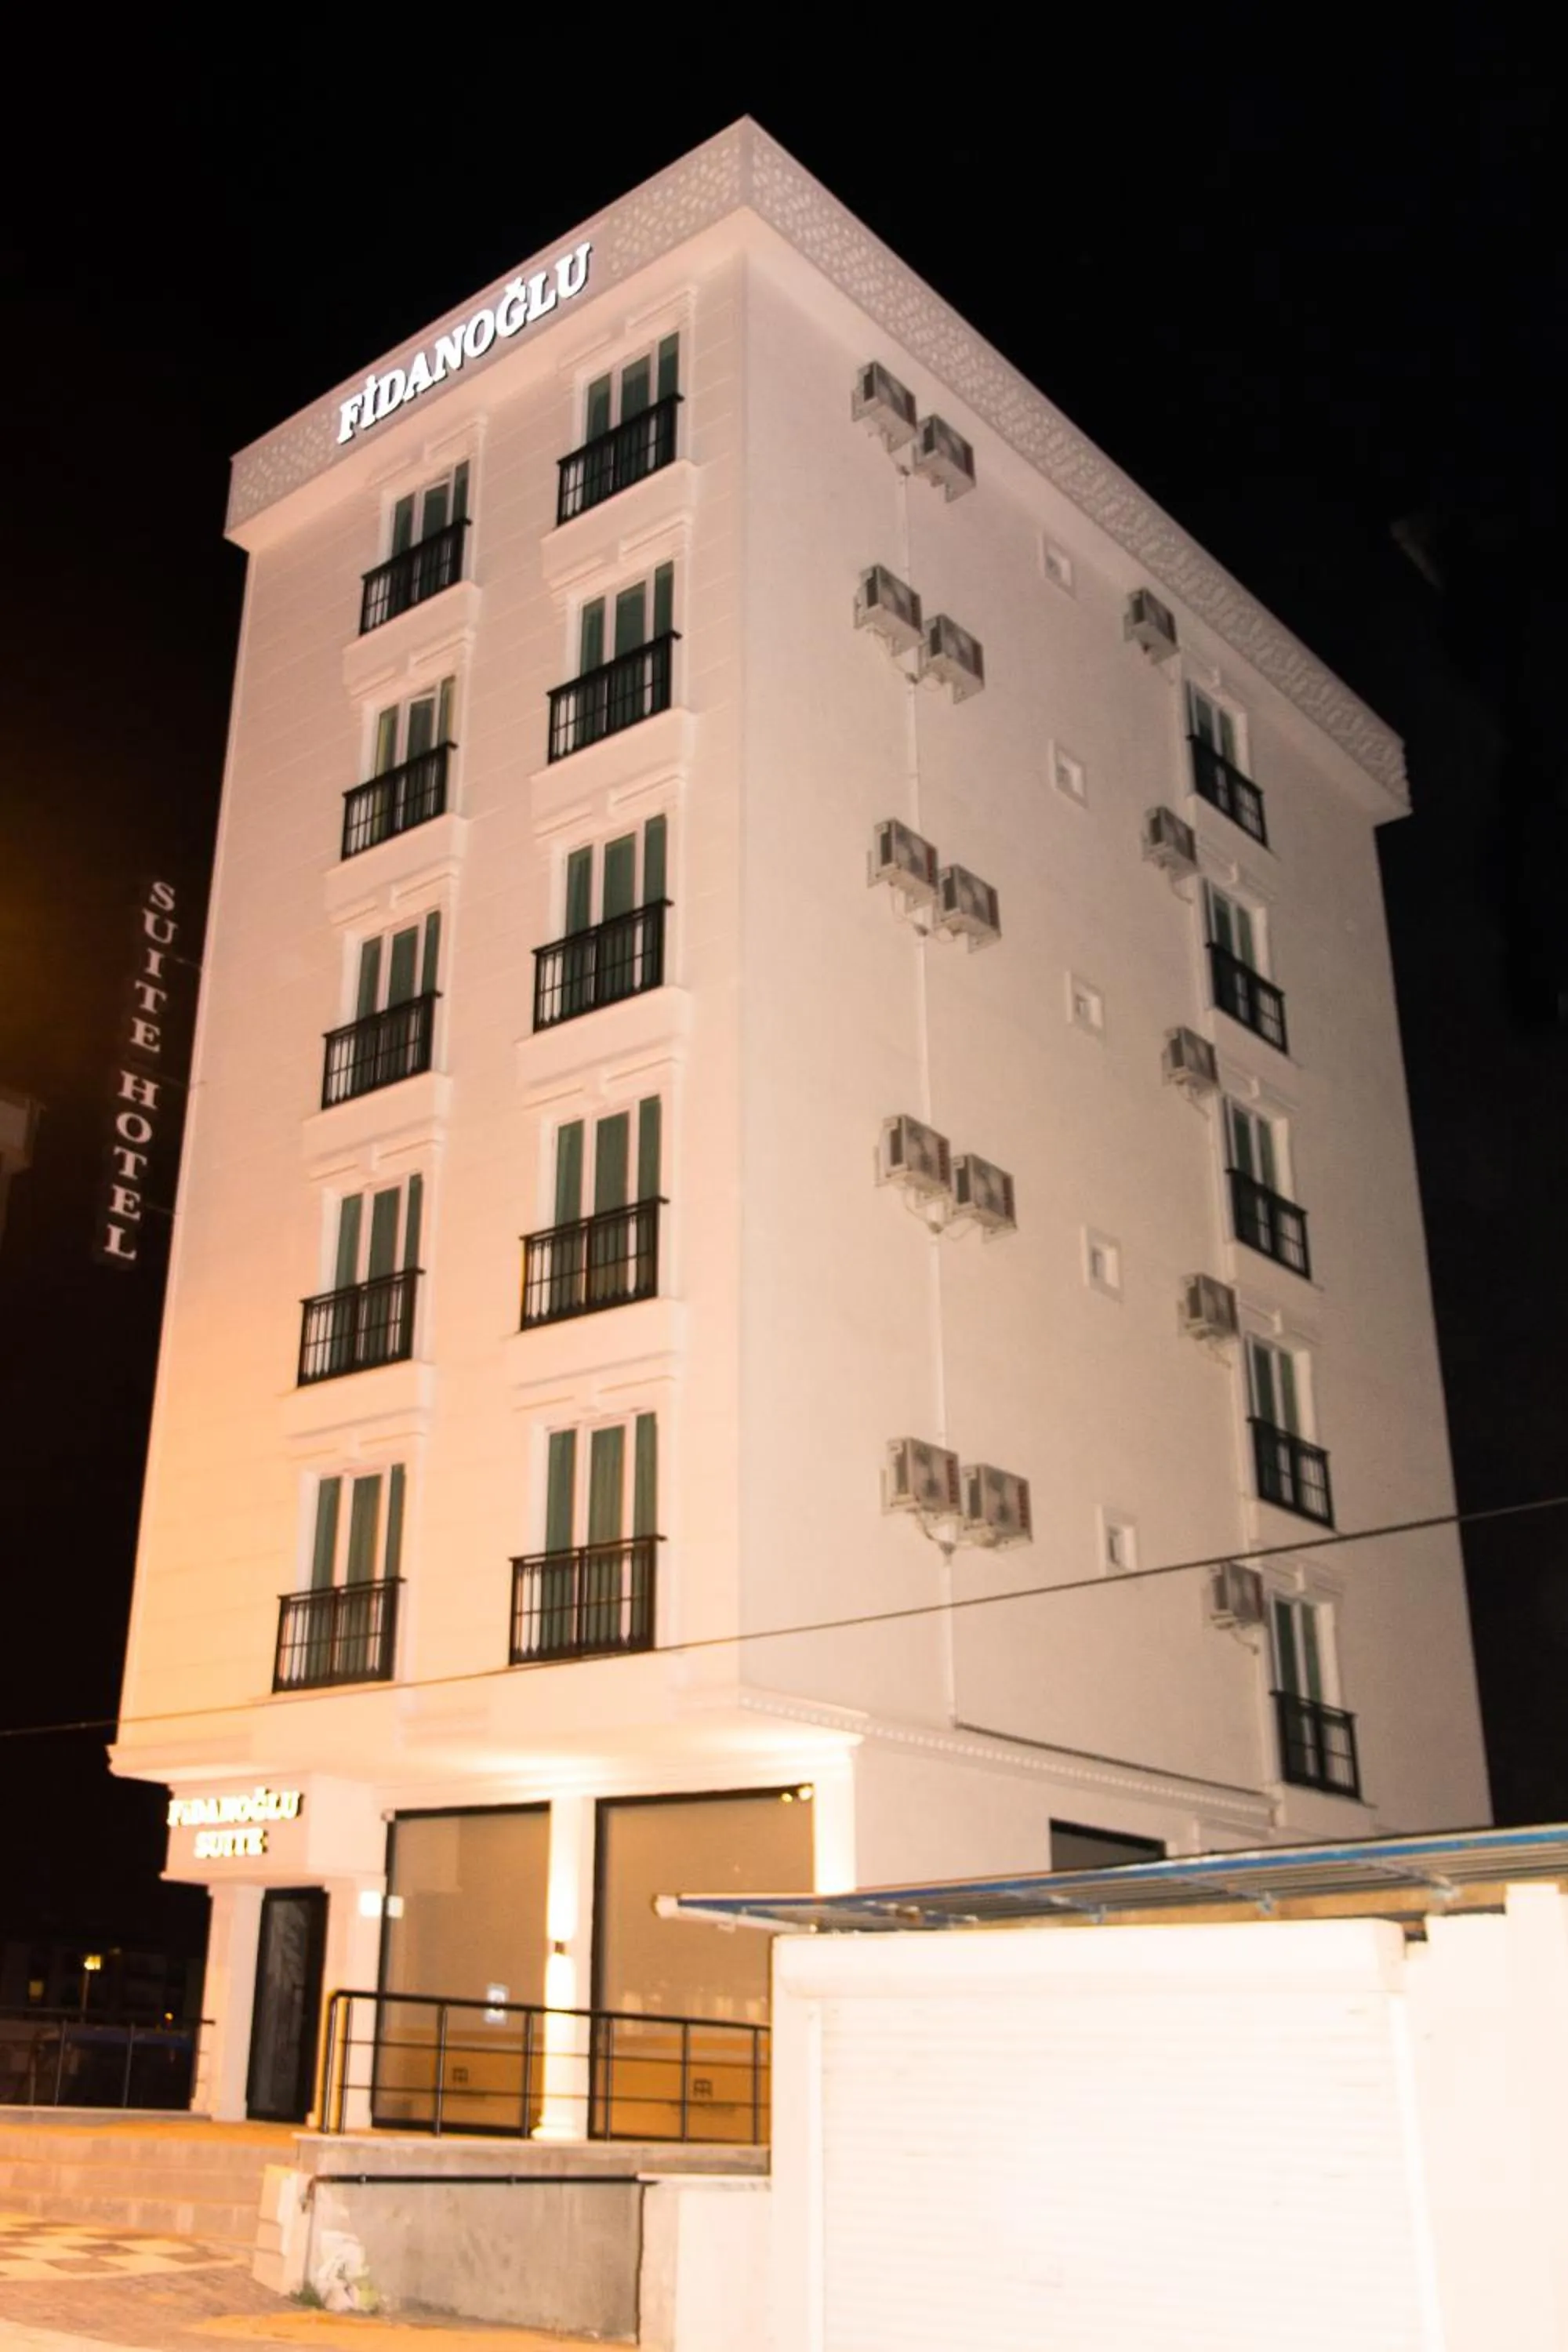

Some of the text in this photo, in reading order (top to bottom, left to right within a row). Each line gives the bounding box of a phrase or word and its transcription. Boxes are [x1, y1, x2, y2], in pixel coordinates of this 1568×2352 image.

[336, 242, 591, 444] FİDANOĞLU
[104, 881, 178, 1260] SUITE HOTEL
[194, 1827, 266, 1859] SUITE
